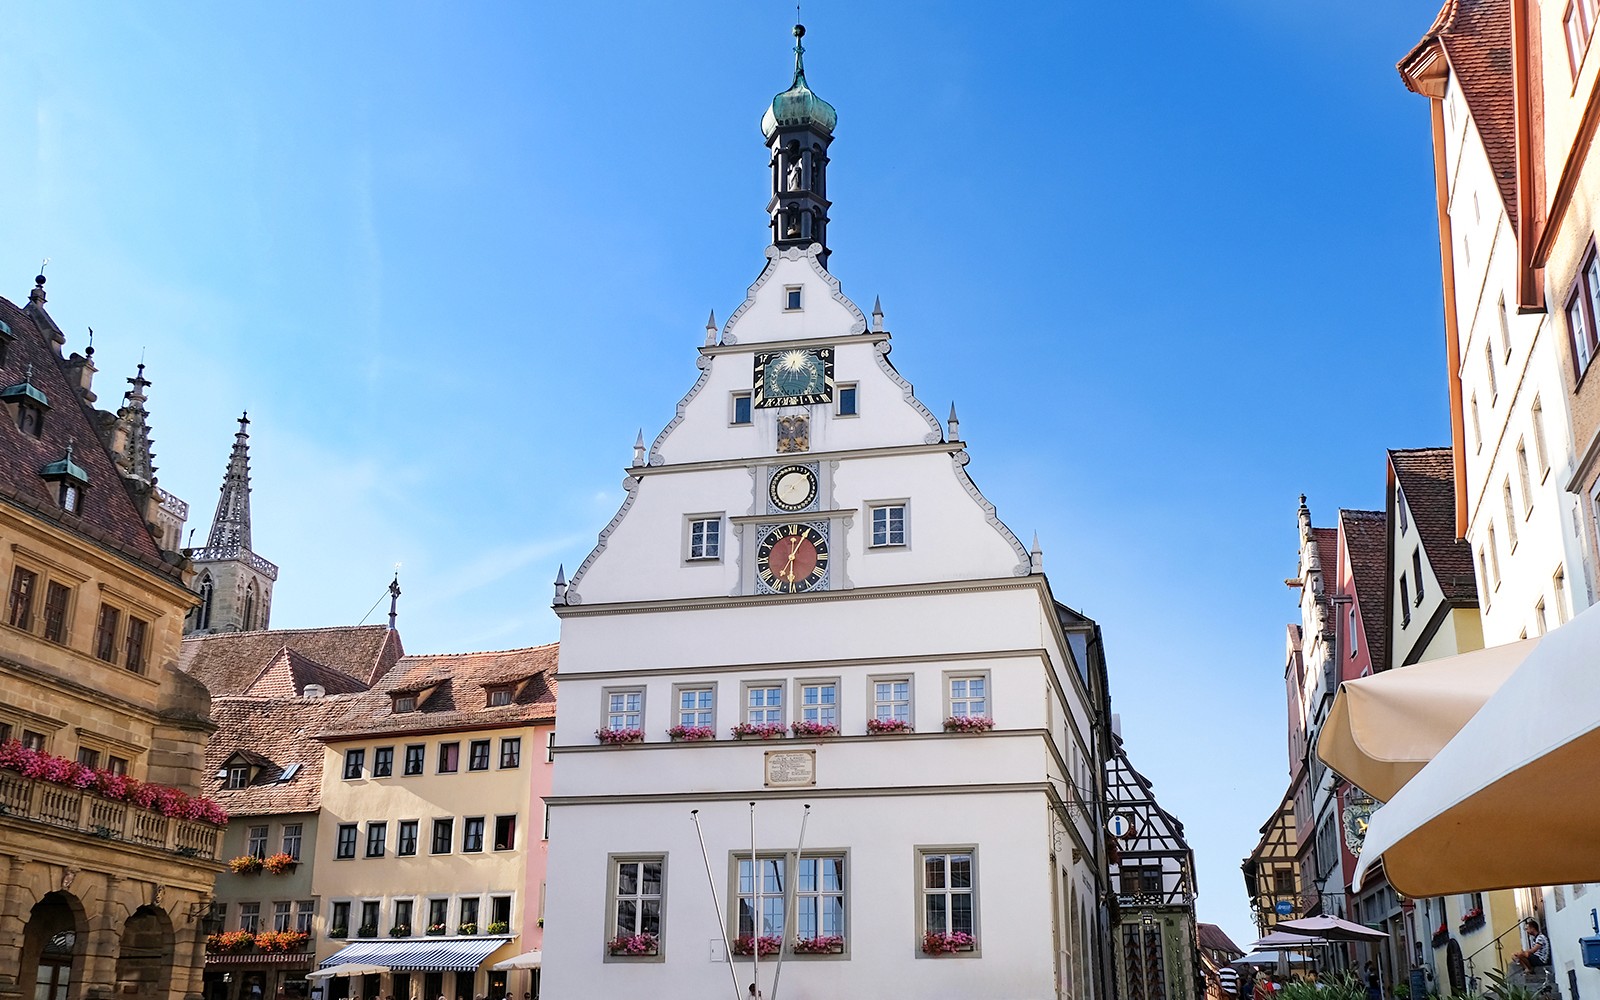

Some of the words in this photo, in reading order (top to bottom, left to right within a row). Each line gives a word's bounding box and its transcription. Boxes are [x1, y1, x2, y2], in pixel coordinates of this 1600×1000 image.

[760, 354, 769, 363] 17
[773, 528, 784, 540] XI
[788, 524, 798, 535] XII
[762, 541, 773, 550] X
[813, 538, 824, 547] II
[757, 556, 768, 565] IX
